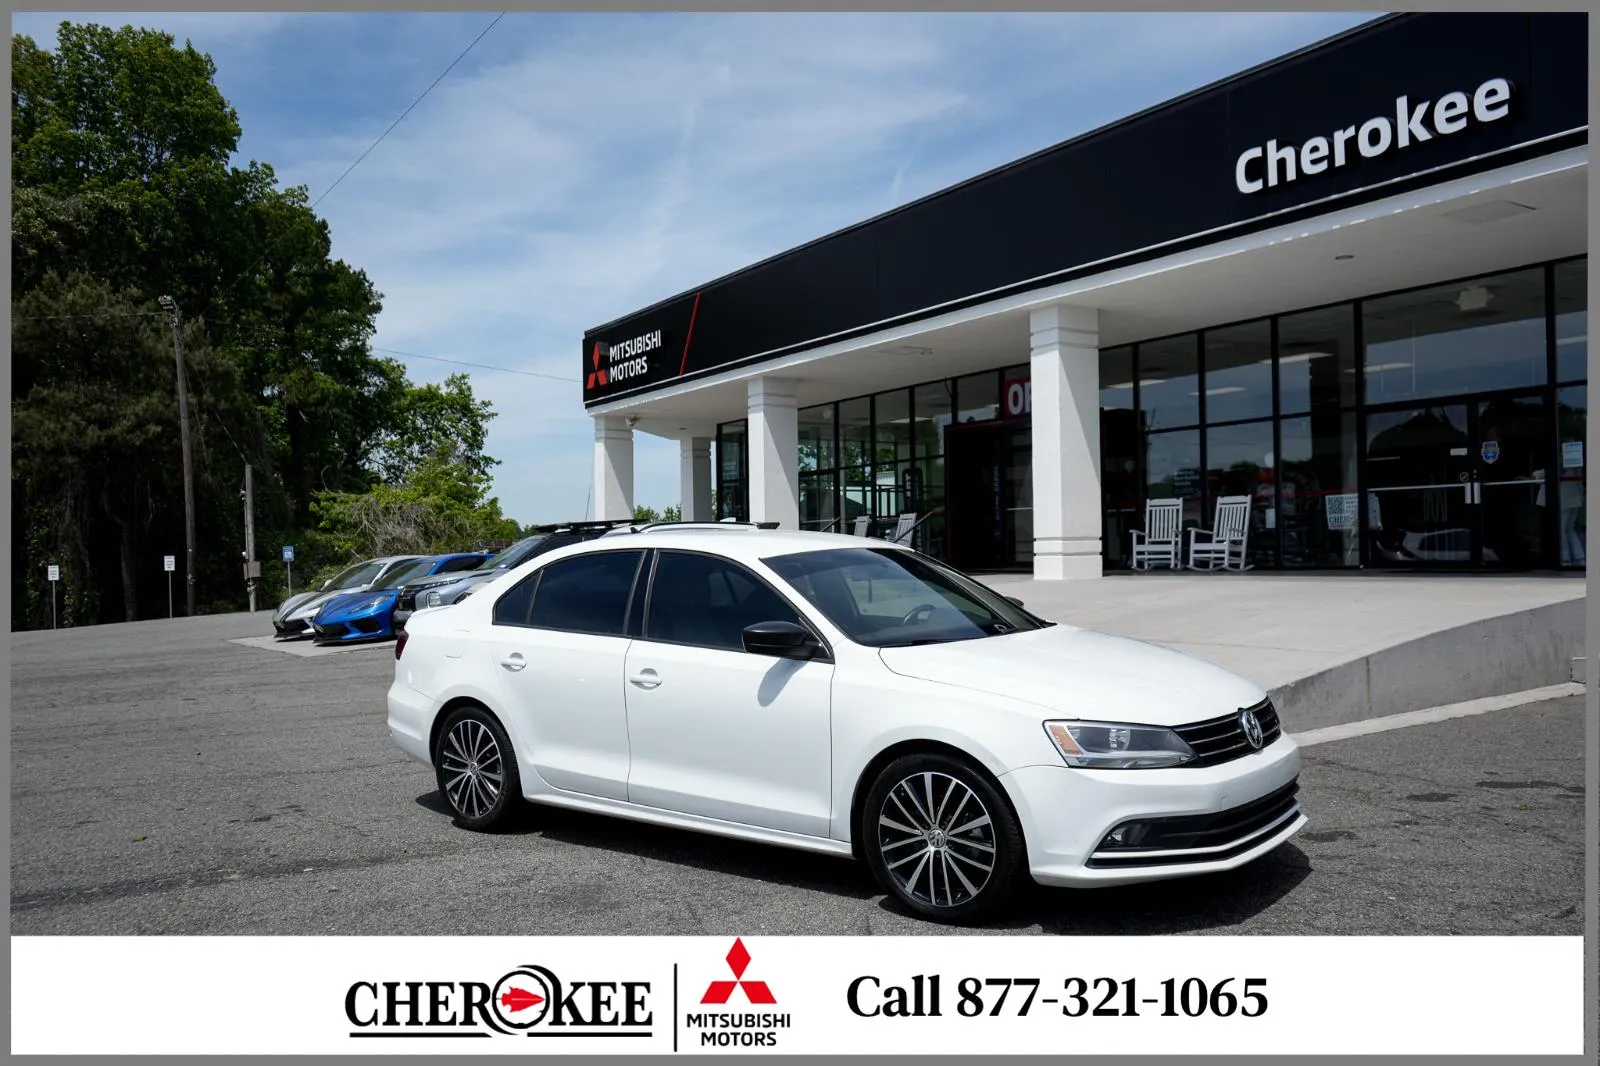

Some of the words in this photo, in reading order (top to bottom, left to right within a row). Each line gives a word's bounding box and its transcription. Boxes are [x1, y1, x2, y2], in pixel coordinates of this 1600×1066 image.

[1236, 78, 1510, 193] Cherokee
[609, 329, 662, 362] MITSUBISHI
[609, 356, 648, 383] MOTORS
